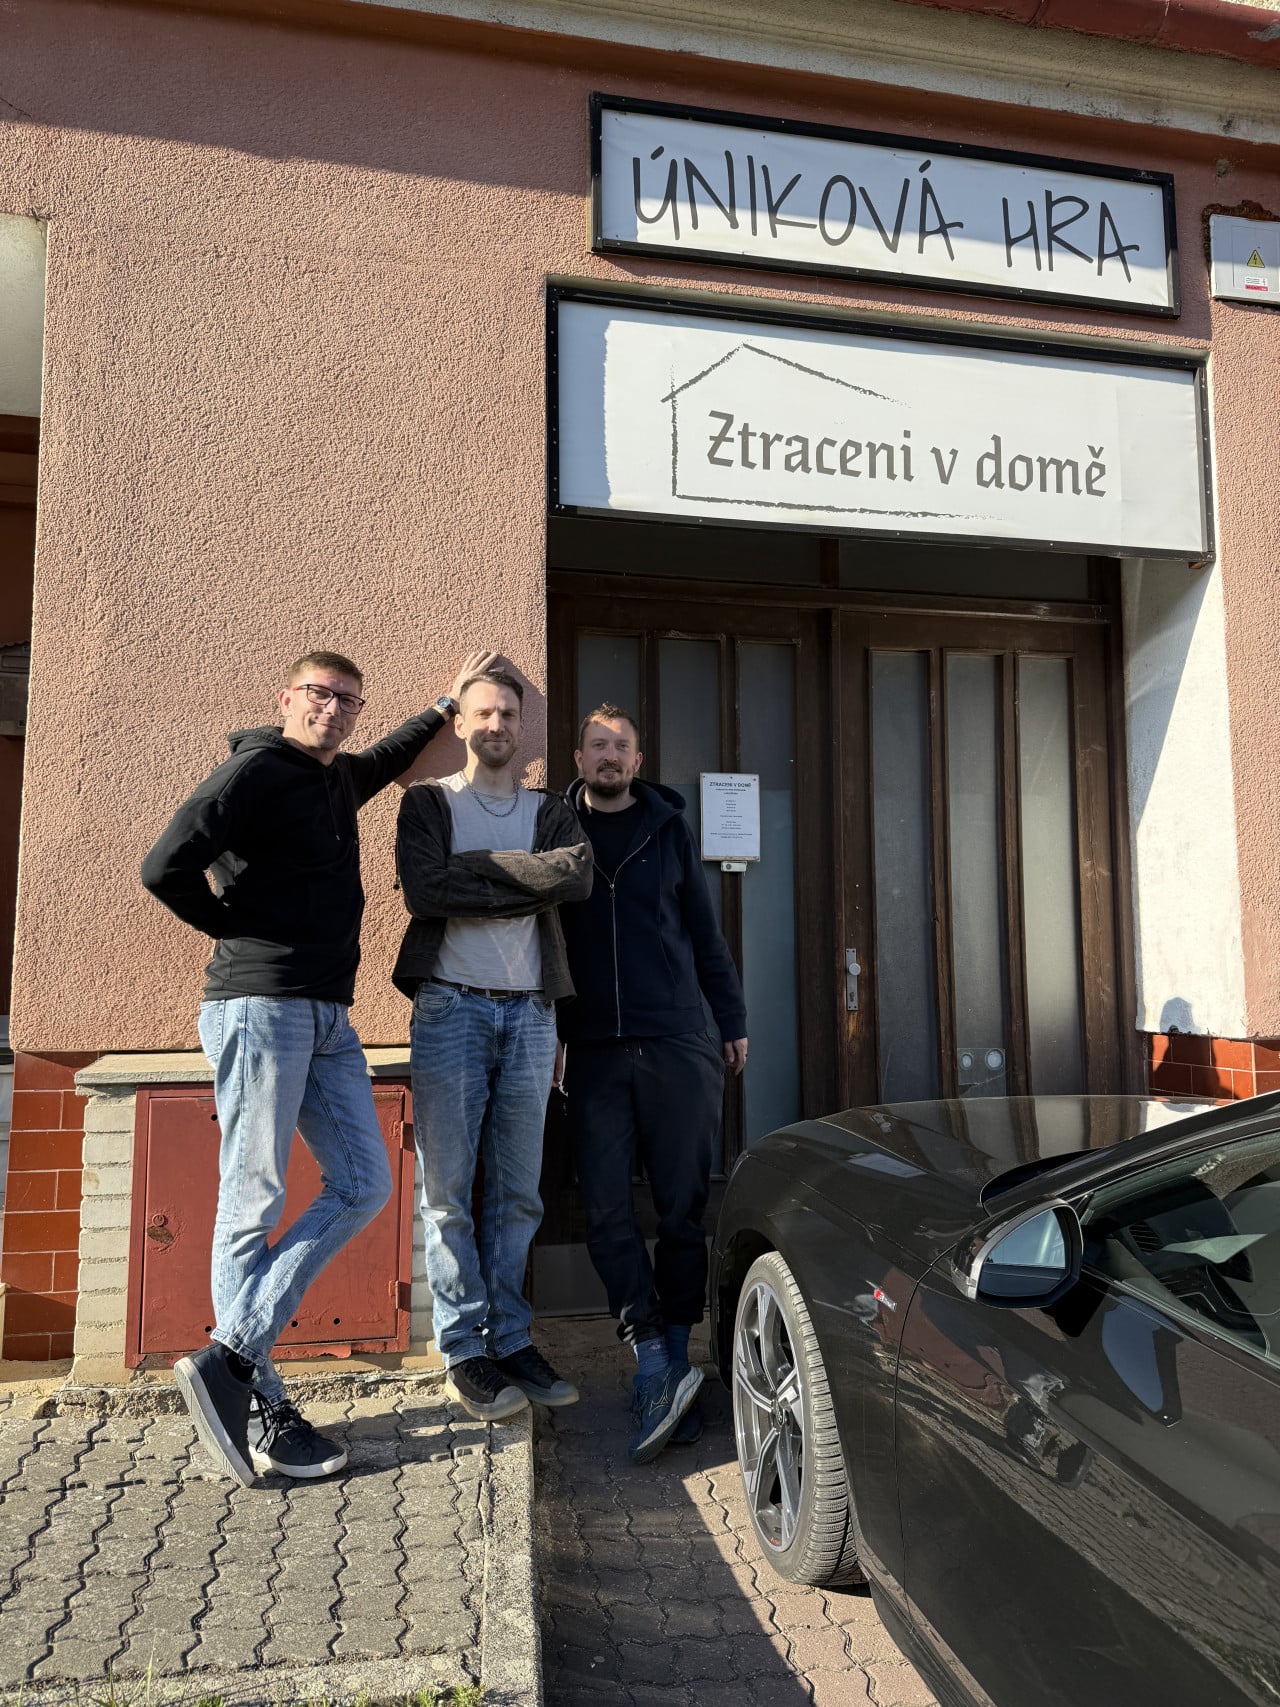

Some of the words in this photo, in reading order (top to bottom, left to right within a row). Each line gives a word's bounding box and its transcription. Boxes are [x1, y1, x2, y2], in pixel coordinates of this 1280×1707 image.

[632, 145, 964, 261] ÚNIKOVÁ
[1001, 189, 1140, 283] HRA
[706, 410, 915, 482] Ztraceni
[930, 446, 959, 485] v
[976, 434, 1107, 498] domě
